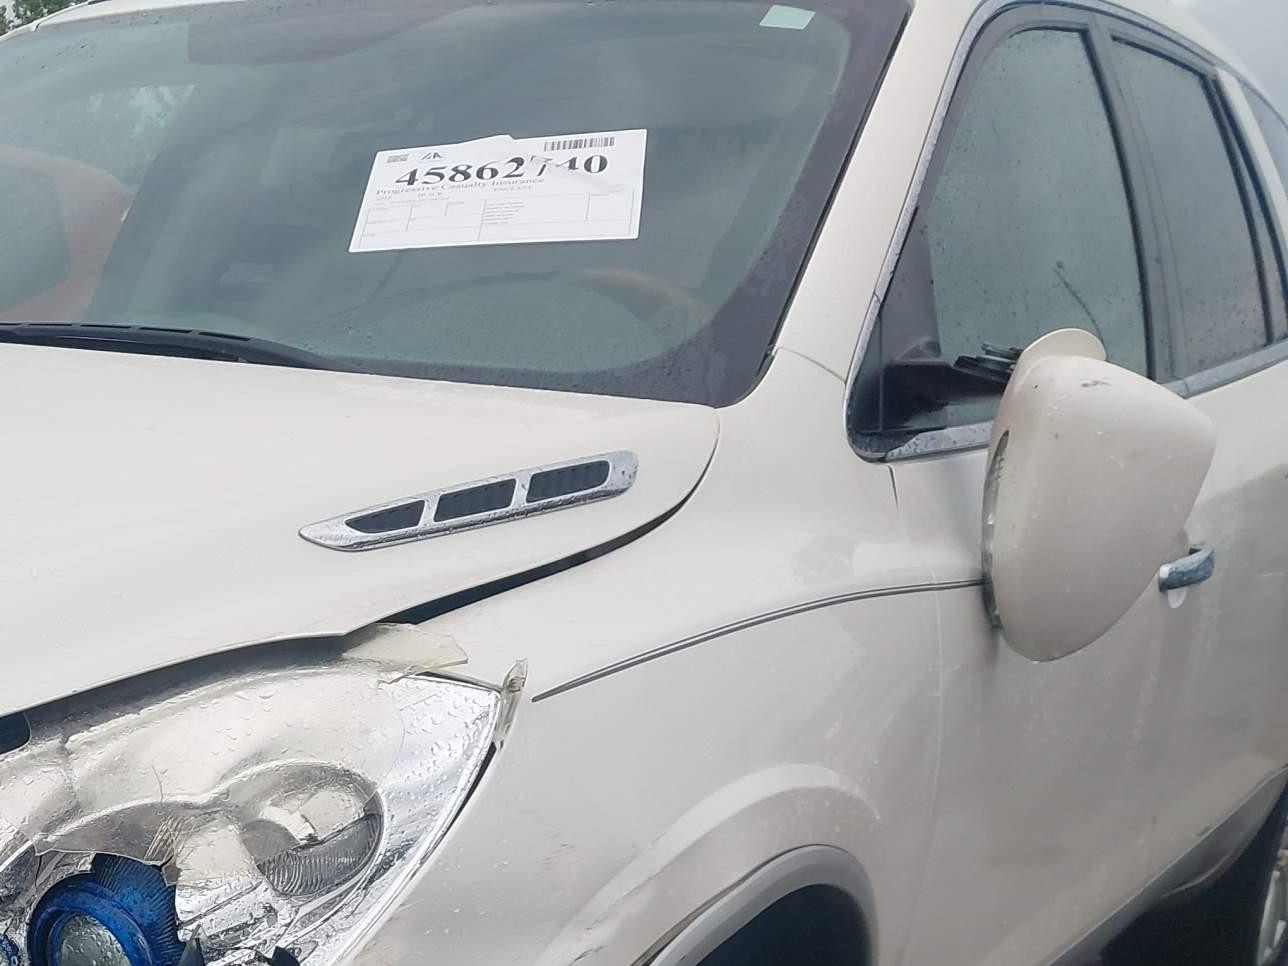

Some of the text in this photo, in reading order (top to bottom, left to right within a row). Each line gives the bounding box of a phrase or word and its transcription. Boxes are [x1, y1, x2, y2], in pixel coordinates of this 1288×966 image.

[395, 153, 609, 187] 45862740
[376, 176, 545, 196] Progressive Casualty Insurance
